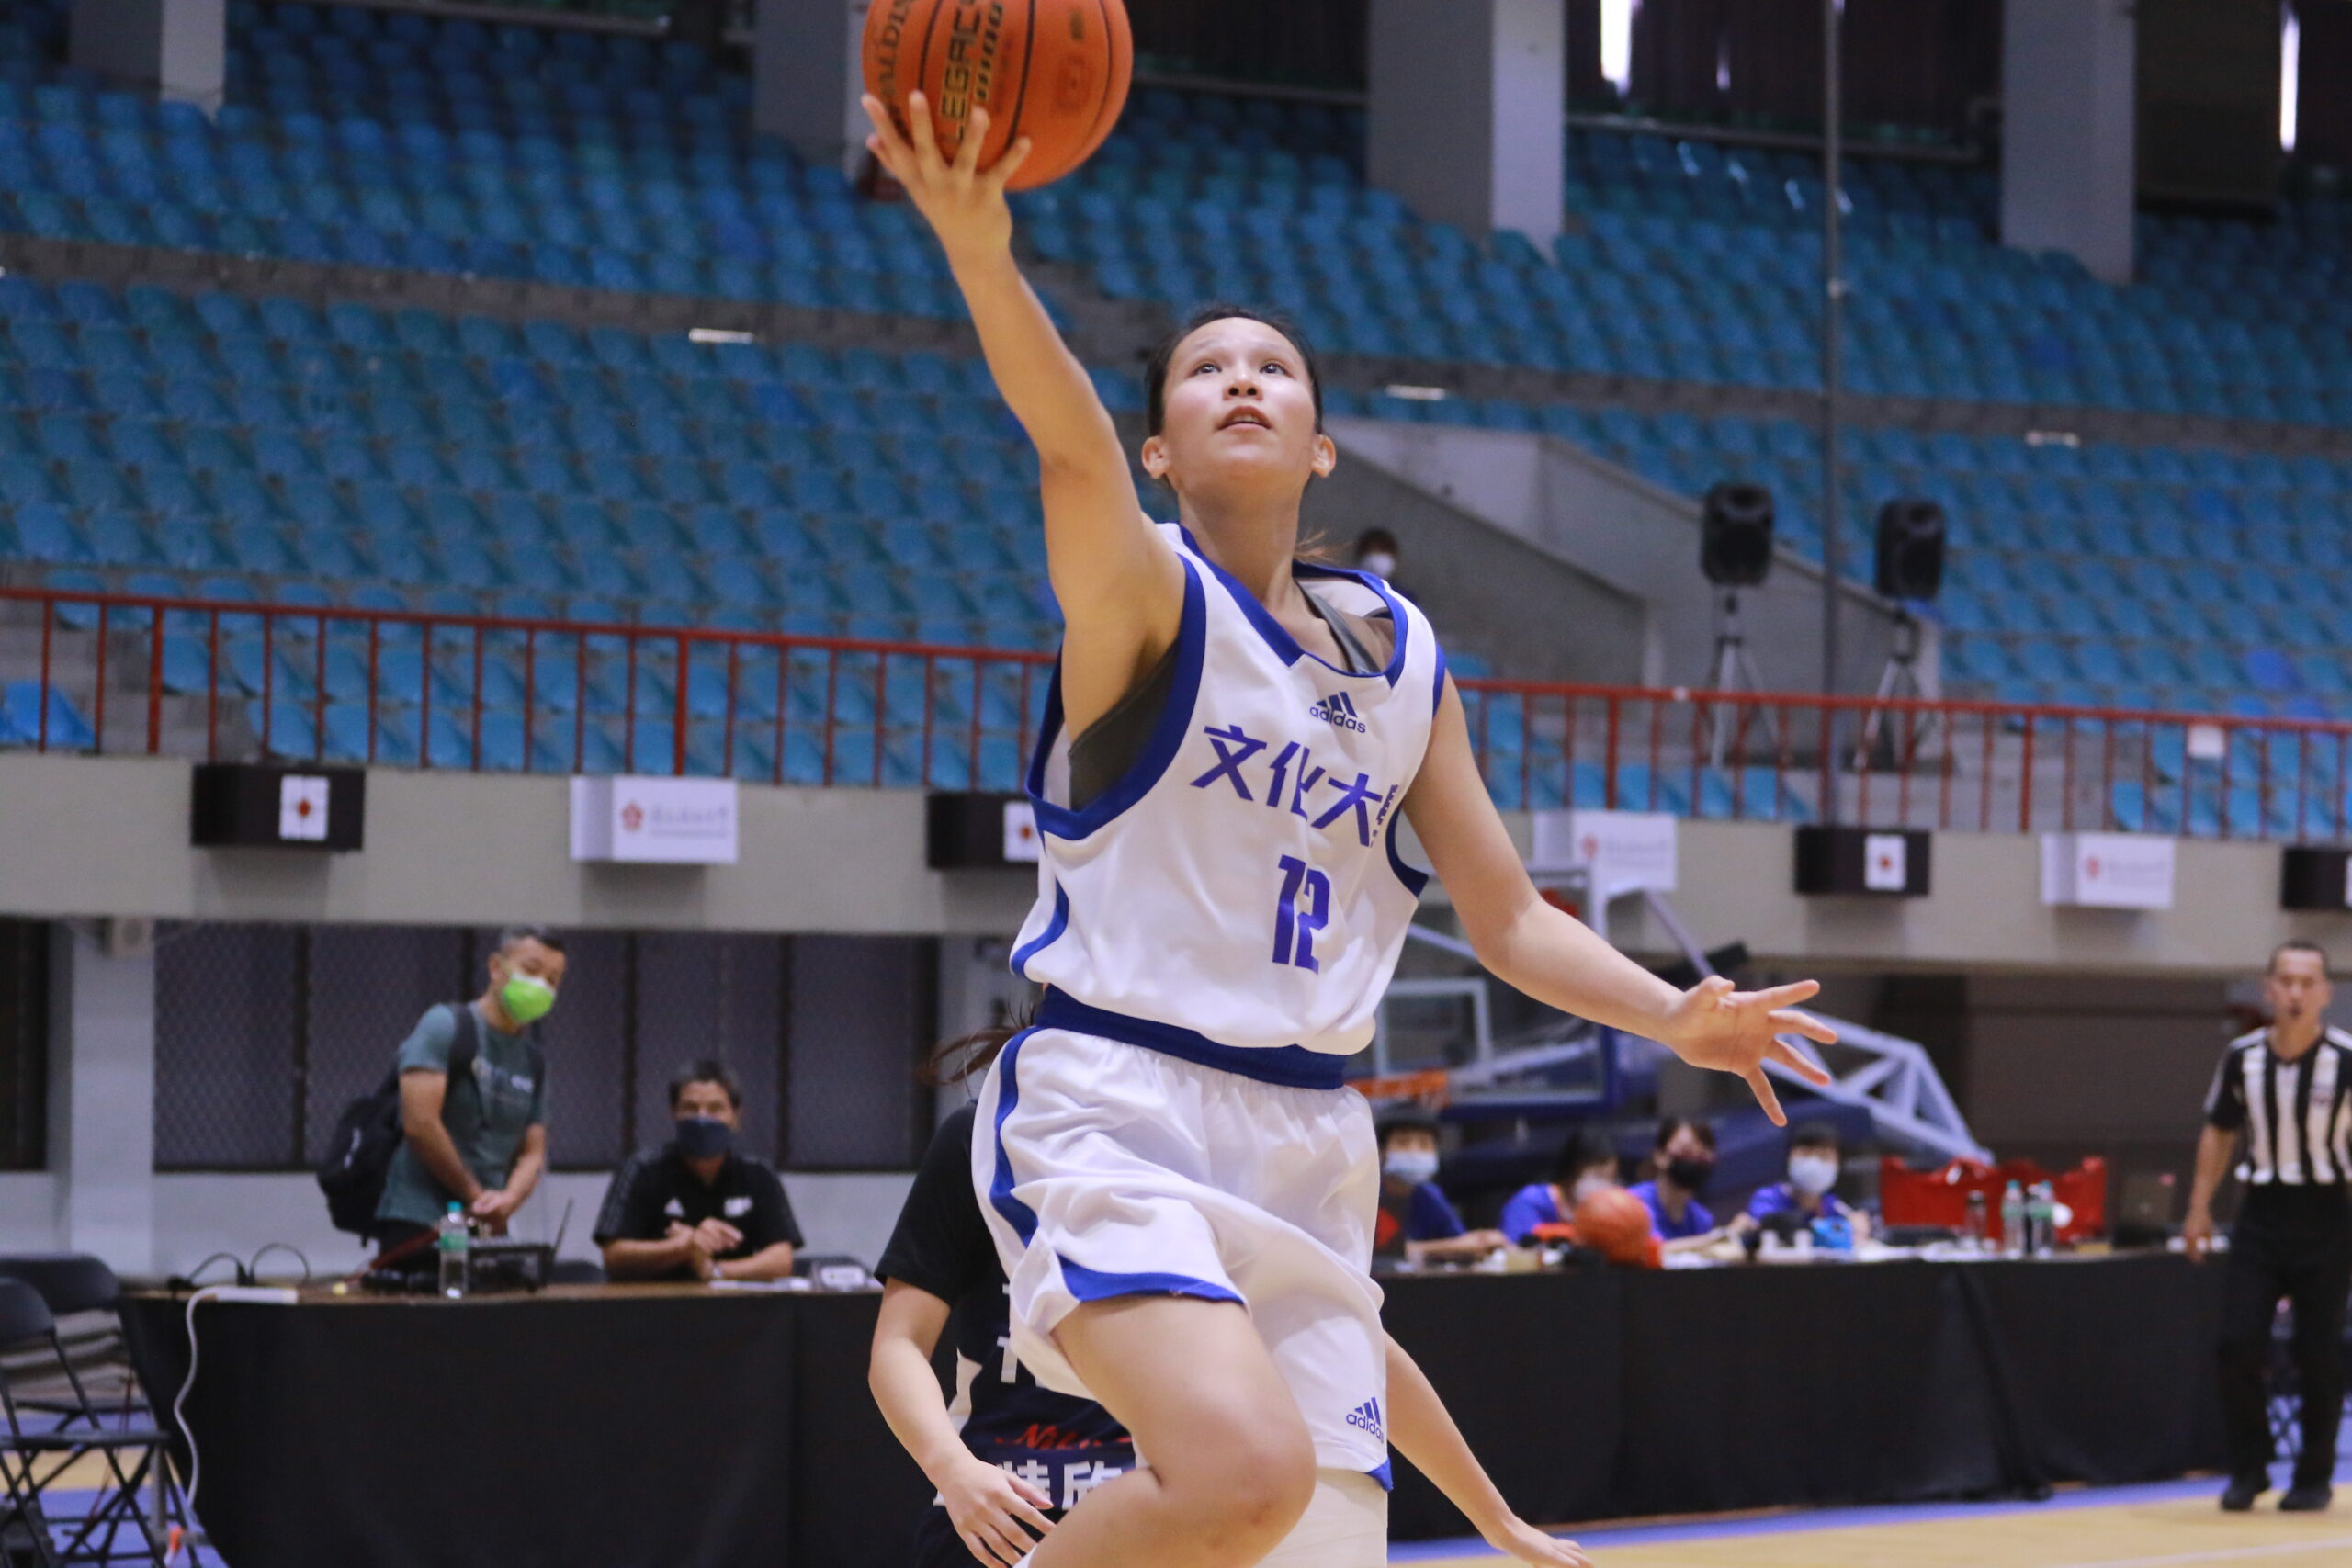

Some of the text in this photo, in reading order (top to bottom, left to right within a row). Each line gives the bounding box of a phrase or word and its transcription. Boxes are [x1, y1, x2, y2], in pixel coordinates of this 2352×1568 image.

[939, 0, 981, 141] LEGAC
[1309, 705, 1366, 734] adidas
[1190, 724, 1399, 848] 文化大
[1272, 854, 1330, 975] 12
[1345, 1413, 1384, 1444] adida
